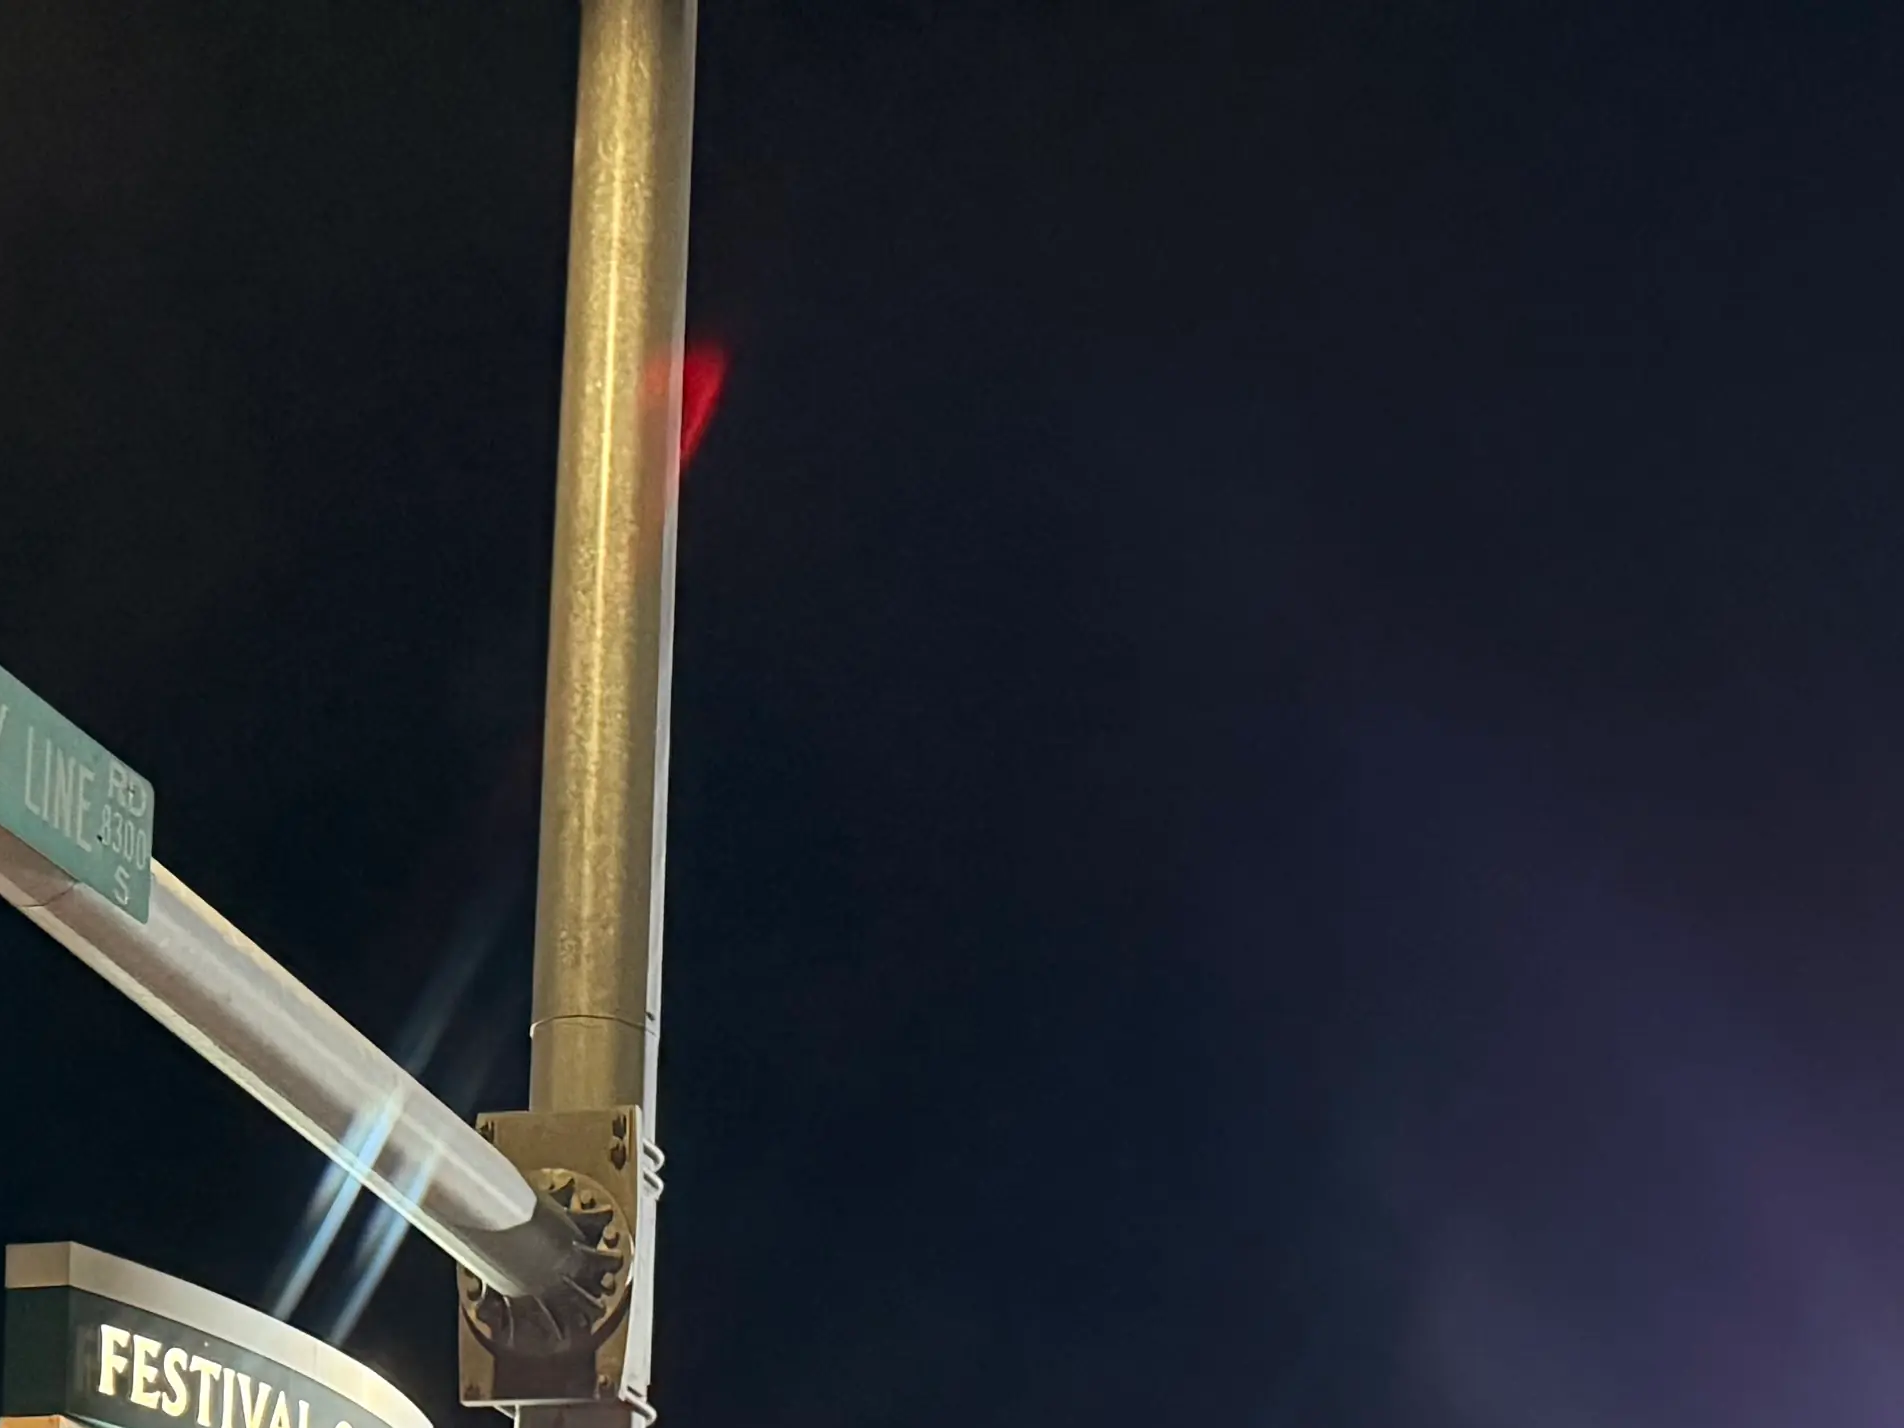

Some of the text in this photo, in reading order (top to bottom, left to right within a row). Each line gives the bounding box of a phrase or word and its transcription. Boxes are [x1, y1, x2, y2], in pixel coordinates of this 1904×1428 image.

[23, 725, 95, 853] LINE
[108, 761, 147, 818] RD
[100, 803, 146, 871] 8300
[114, 865, 132, 905] S
